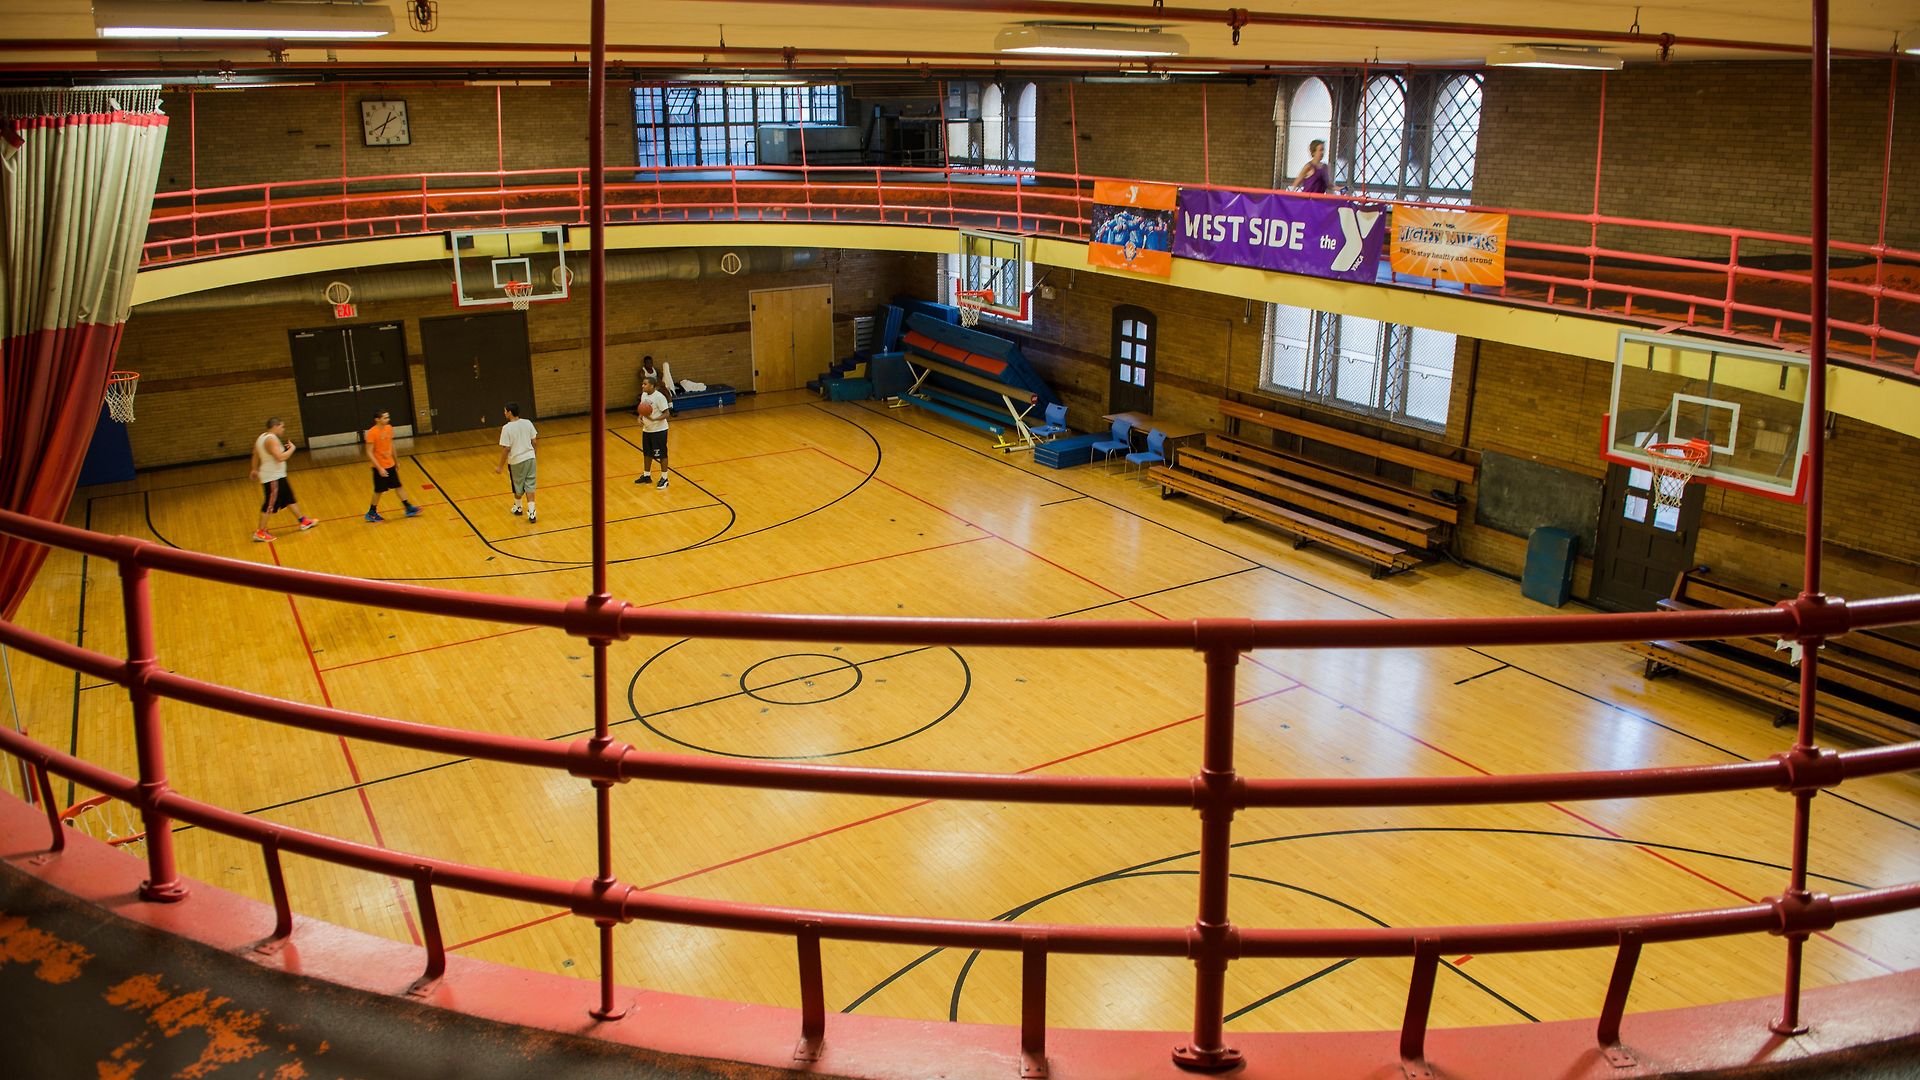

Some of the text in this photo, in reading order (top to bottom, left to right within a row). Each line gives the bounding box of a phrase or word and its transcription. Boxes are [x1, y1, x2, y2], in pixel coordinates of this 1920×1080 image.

[1184, 210, 1306, 250] WEST SIDE
[1319, 234, 1336, 250] the
[1417, 250, 1430, 258] stay
[1431, 252, 1455, 261] healthy
[1469, 257, 1493, 265] strong
[337, 303, 355, 318] EXIT
